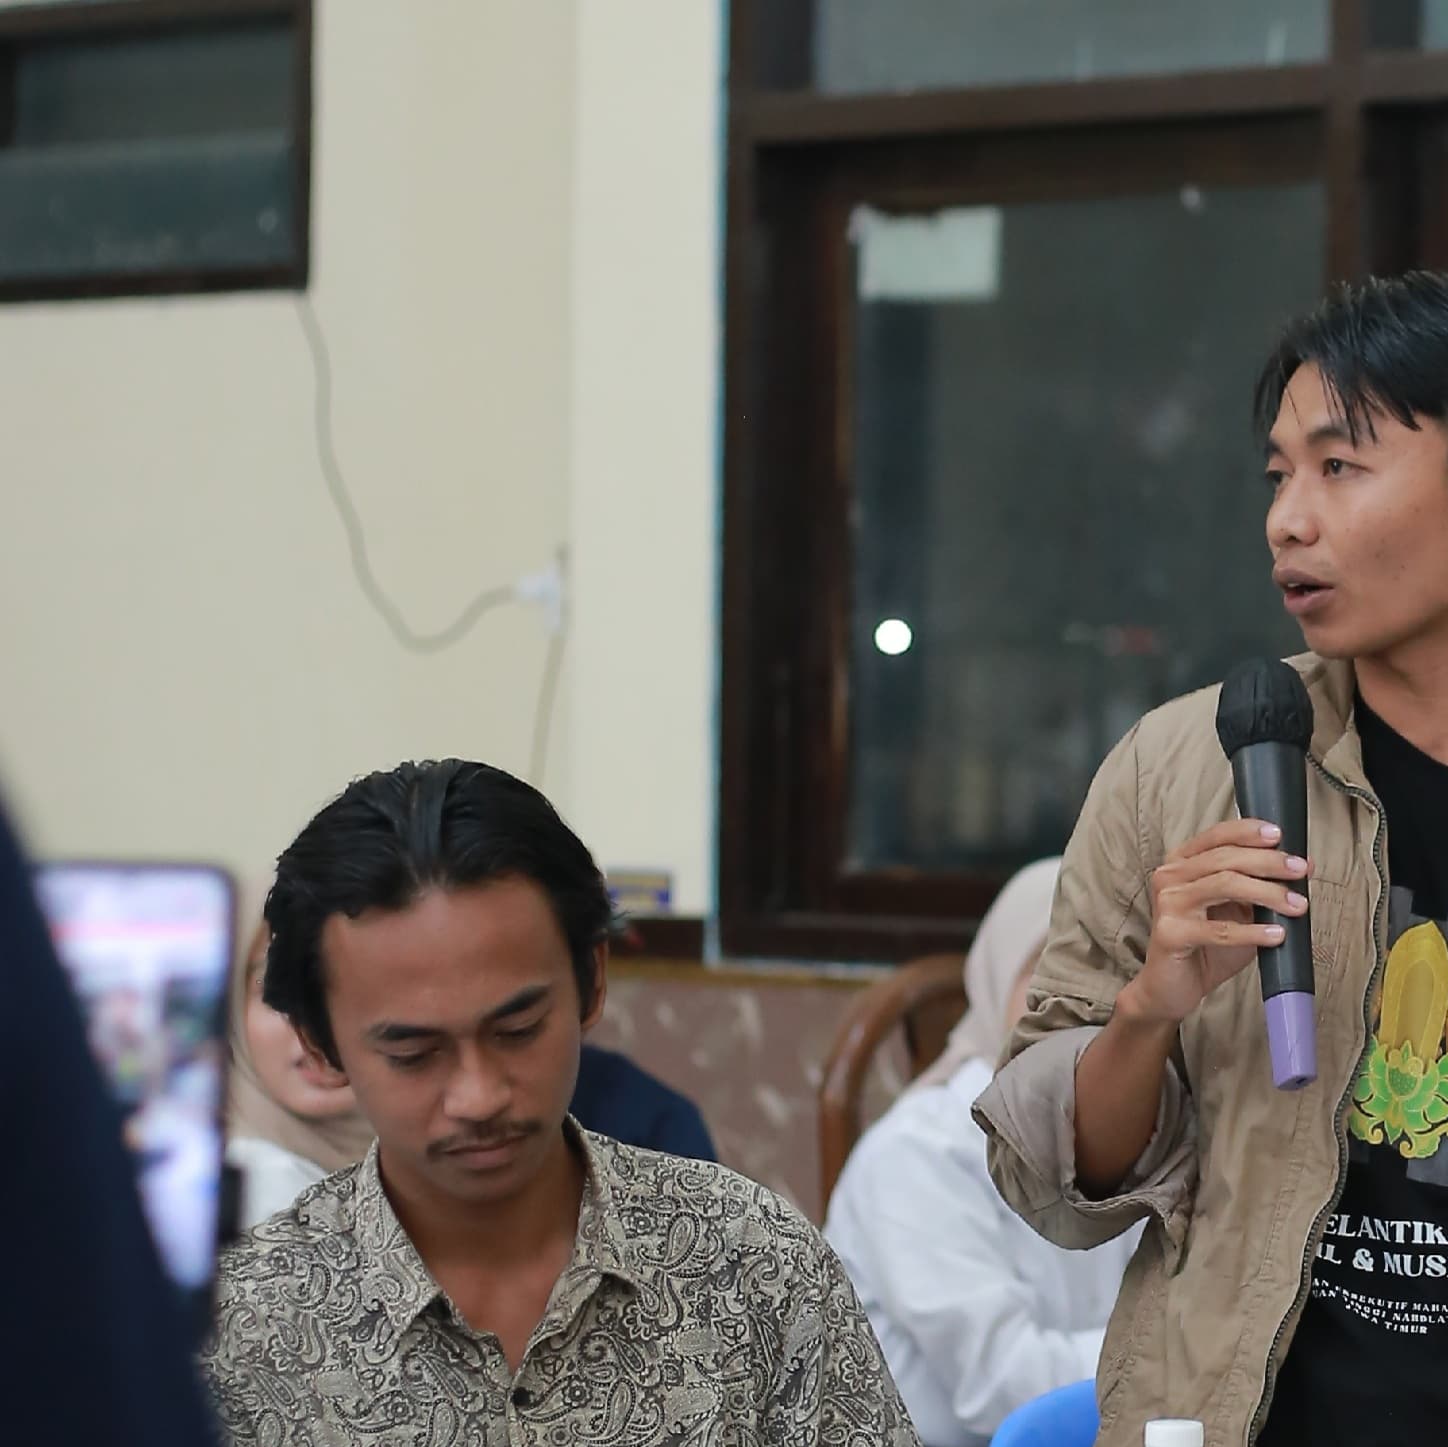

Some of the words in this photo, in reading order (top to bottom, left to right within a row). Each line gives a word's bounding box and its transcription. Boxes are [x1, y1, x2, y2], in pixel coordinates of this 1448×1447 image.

[1315, 1242, 1342, 1265] IL
[1352, 1248, 1374, 1272] &
[1312, 1278, 1329, 1287] AN
[1312, 1289, 1336, 1298] UAN
[1384, 1320, 1428, 1334] TIMUR
